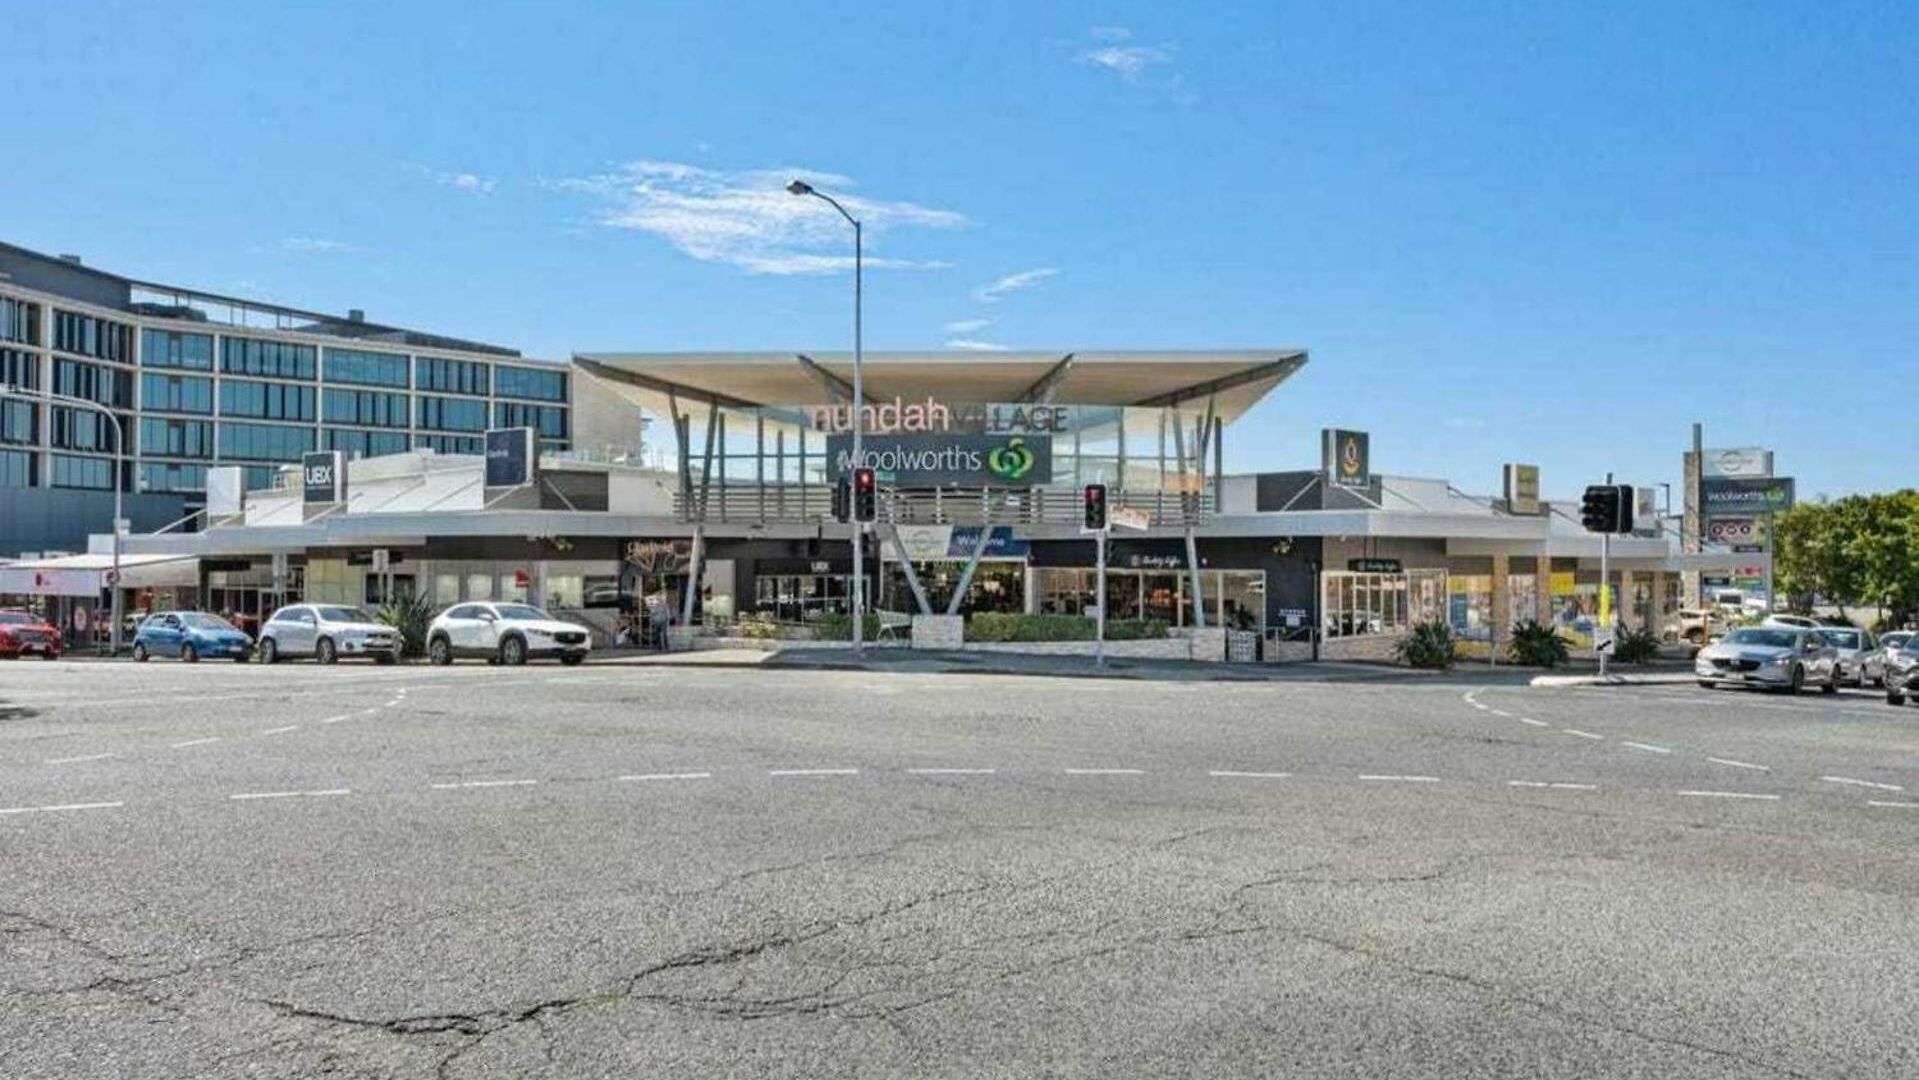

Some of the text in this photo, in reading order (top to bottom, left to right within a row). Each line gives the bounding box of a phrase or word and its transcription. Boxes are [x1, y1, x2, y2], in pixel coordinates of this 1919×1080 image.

[811, 396, 1068, 432] nundah VLAGE
[838, 444, 981, 472] Woolworths
[306, 465, 332, 486] UBX
[956, 533, 1005, 547] Welome
